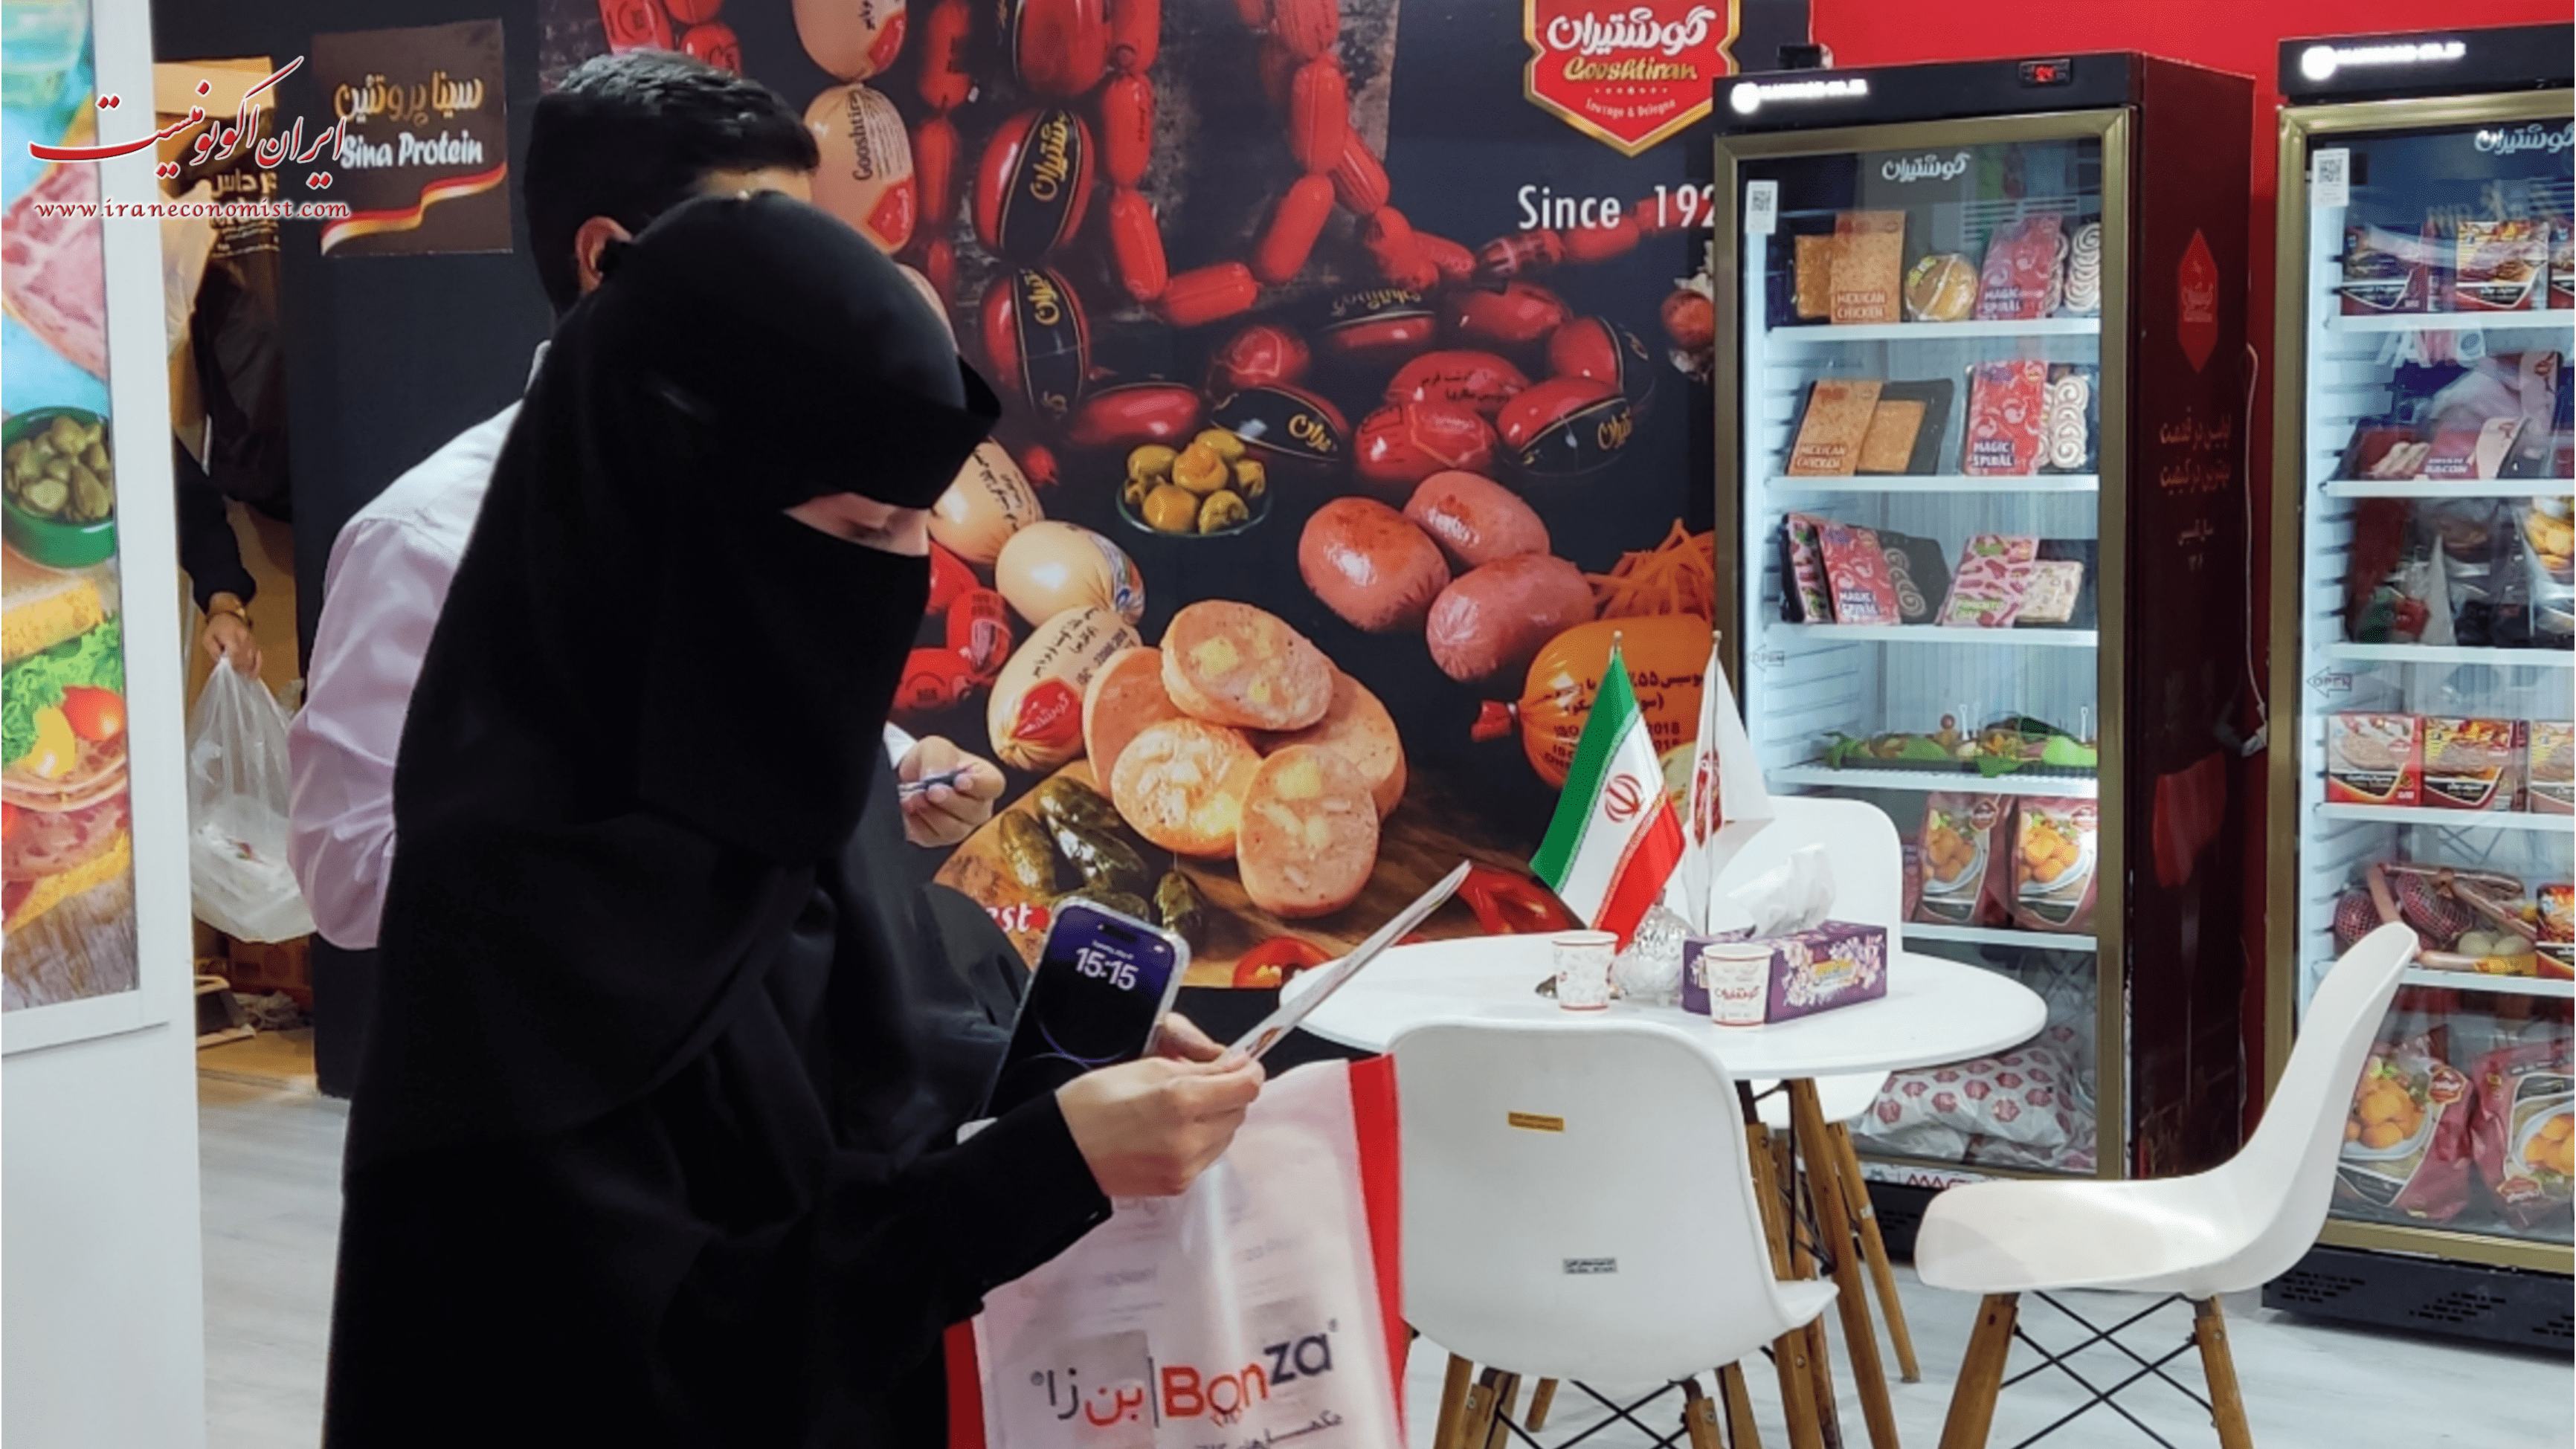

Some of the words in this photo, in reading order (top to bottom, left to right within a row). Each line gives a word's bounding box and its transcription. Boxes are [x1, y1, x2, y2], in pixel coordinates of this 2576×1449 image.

[1547, 5, 1717, 56] گوشتیران
[1563, 56, 1698, 80] Gooshtiran
[431, 72, 485, 122] سینا
[341, 131, 393, 170] Sina
[398, 129, 483, 167] Protein
[1518, 185, 1621, 230] Since
[1653, 184, 1715, 228] 192
[1075, 947, 1139, 991] 15:15
[1161, 1333, 1333, 1418] Bonza
